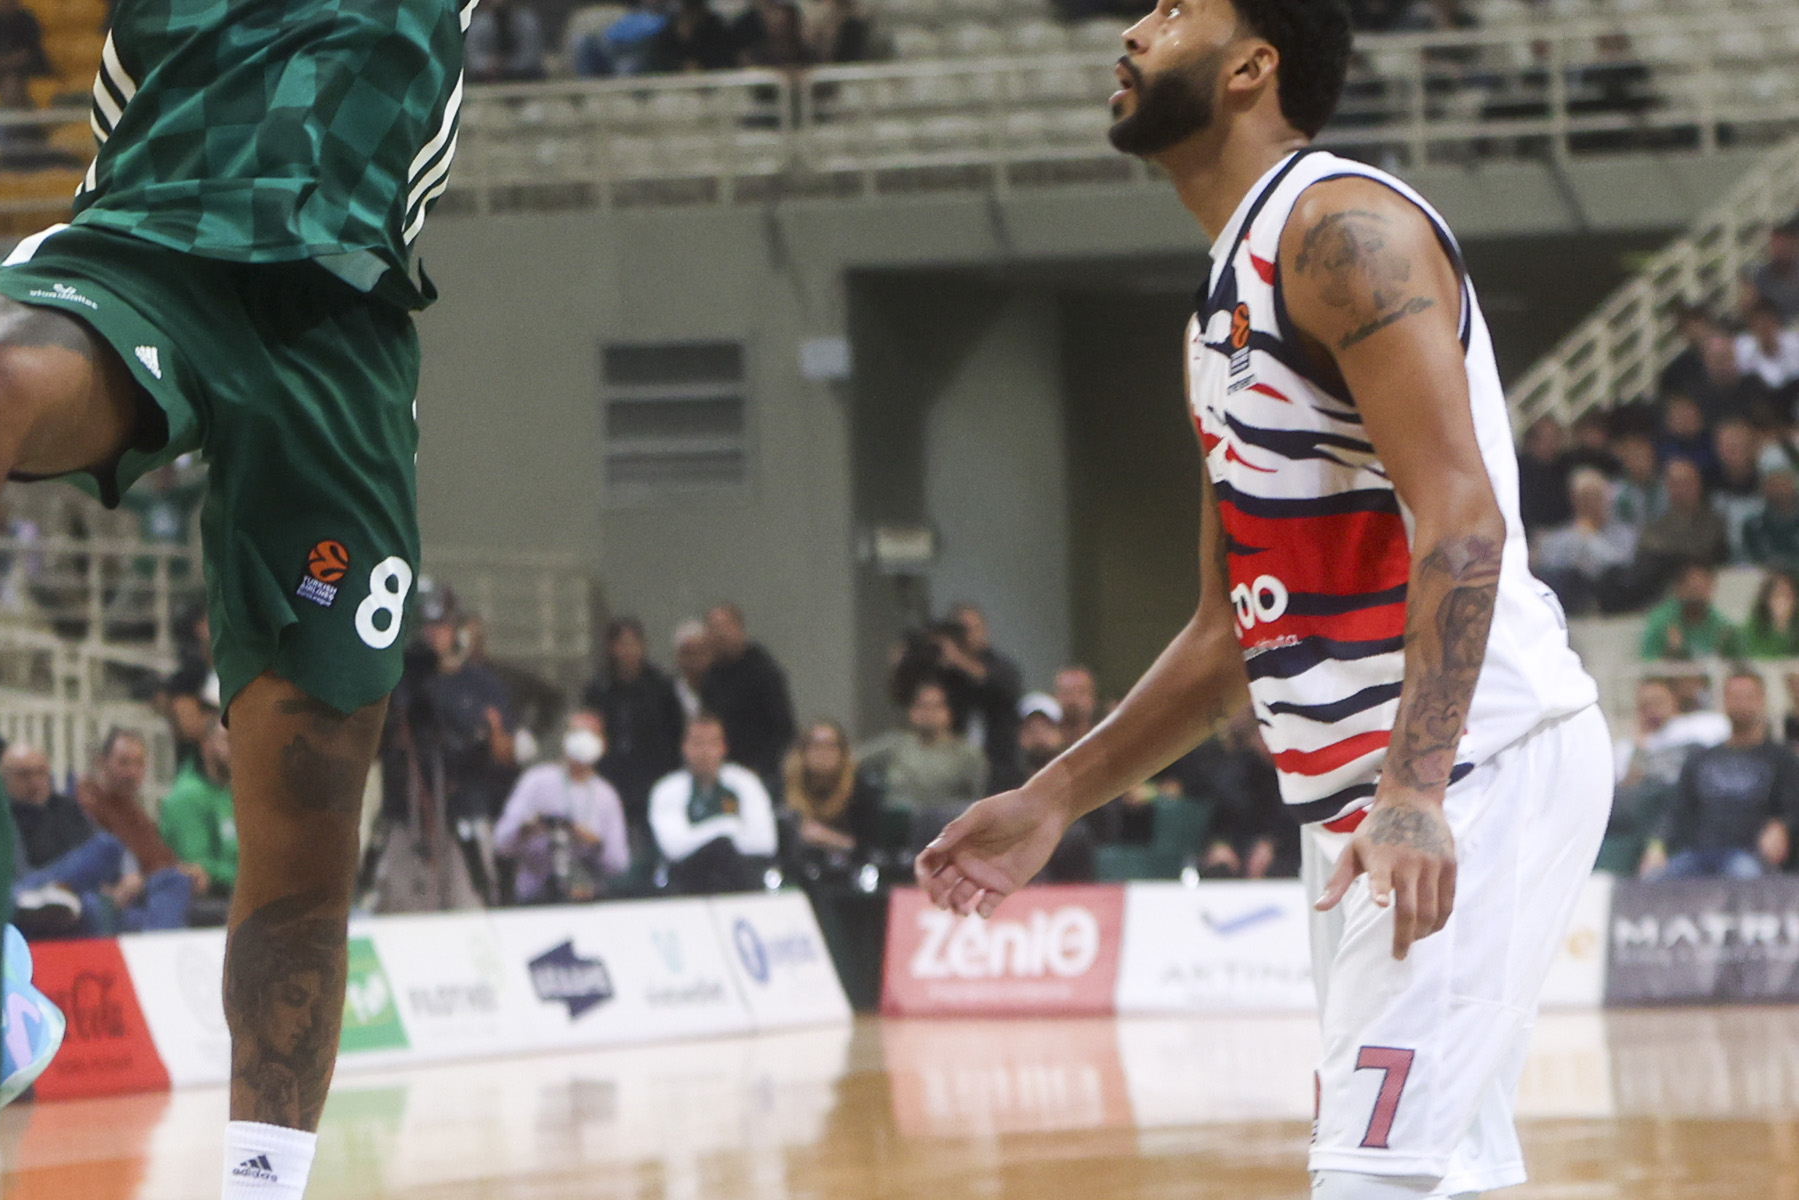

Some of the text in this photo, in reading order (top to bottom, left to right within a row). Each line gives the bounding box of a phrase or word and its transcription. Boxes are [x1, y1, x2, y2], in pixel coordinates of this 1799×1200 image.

[354, 556, 413, 649] 8
[1354, 1045, 1416, 1149] 7
[232, 1168, 278, 1183] adidas
